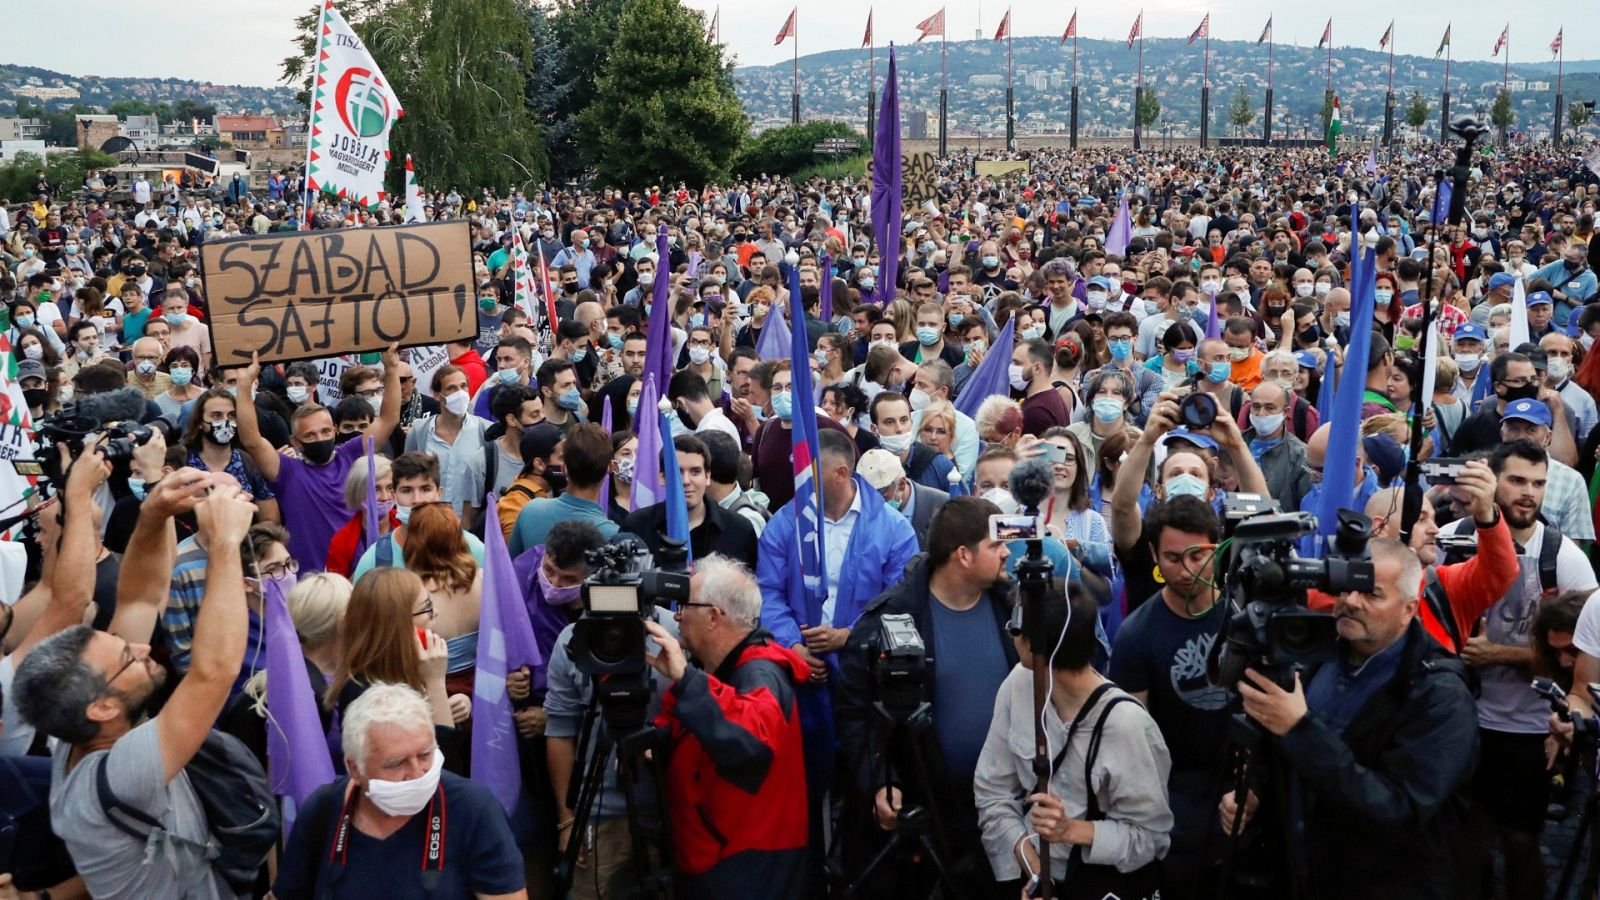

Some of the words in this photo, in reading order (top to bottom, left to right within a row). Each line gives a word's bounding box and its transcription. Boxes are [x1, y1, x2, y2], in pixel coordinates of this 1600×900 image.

[336, 33, 364, 51] TISZ
[330, 133, 380, 165] JOBBIK
[219, 231, 441, 305] SZABAD
[431, 816, 441, 830] 6D
[429, 832, 440, 859] EOS
